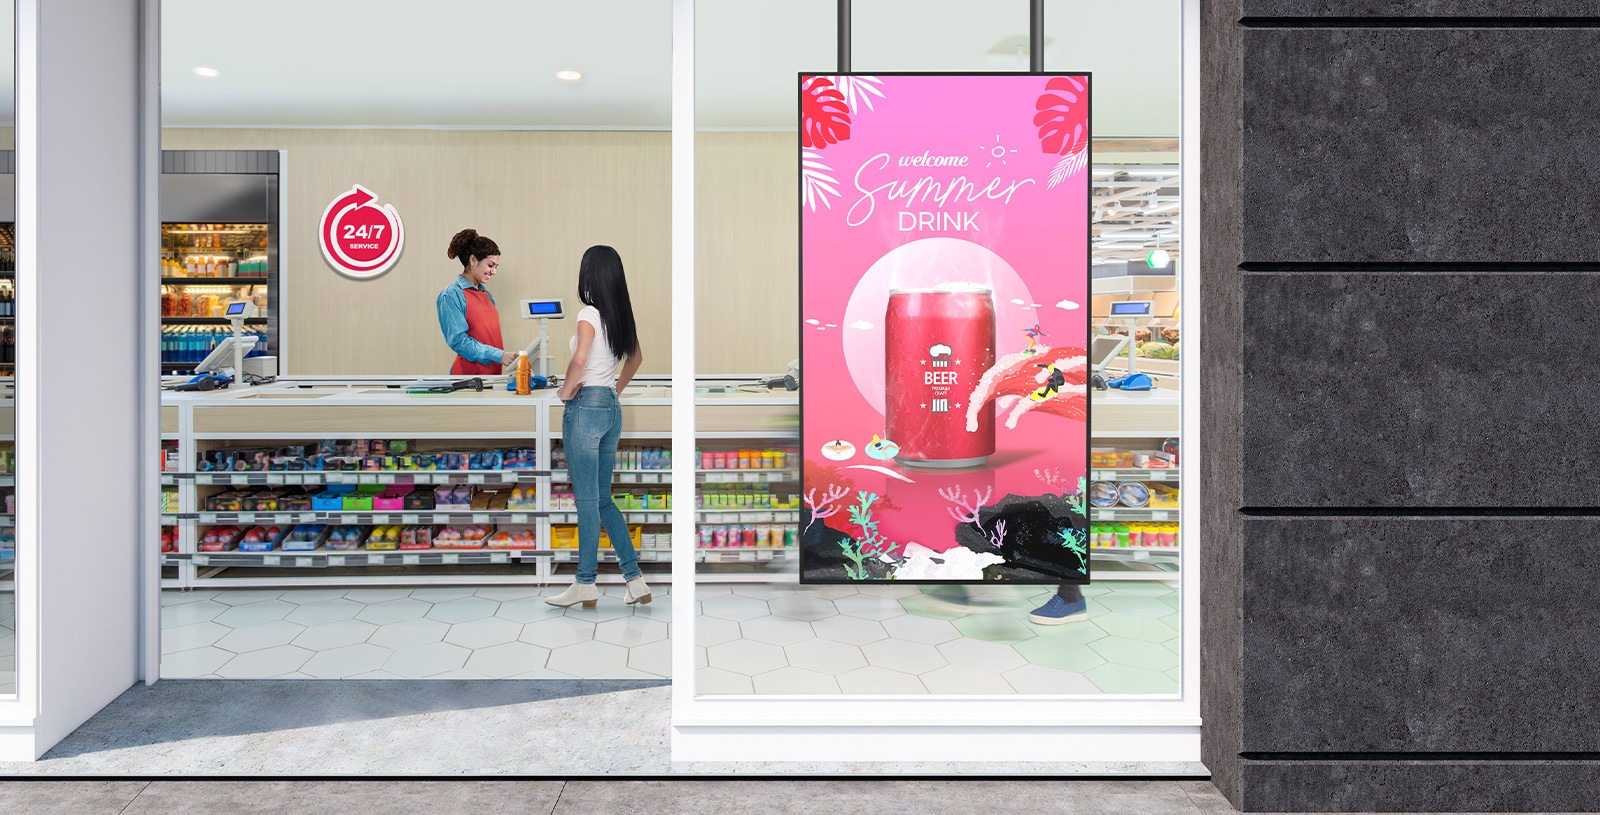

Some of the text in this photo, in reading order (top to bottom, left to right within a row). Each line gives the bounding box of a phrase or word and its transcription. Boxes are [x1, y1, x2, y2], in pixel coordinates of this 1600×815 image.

[898, 150, 969, 167] welcome
[846, 152, 1036, 227] Summer
[899, 211, 980, 232] DRINK
[343, 224, 385, 240] 24/7
[924, 371, 959, 385] BEER
